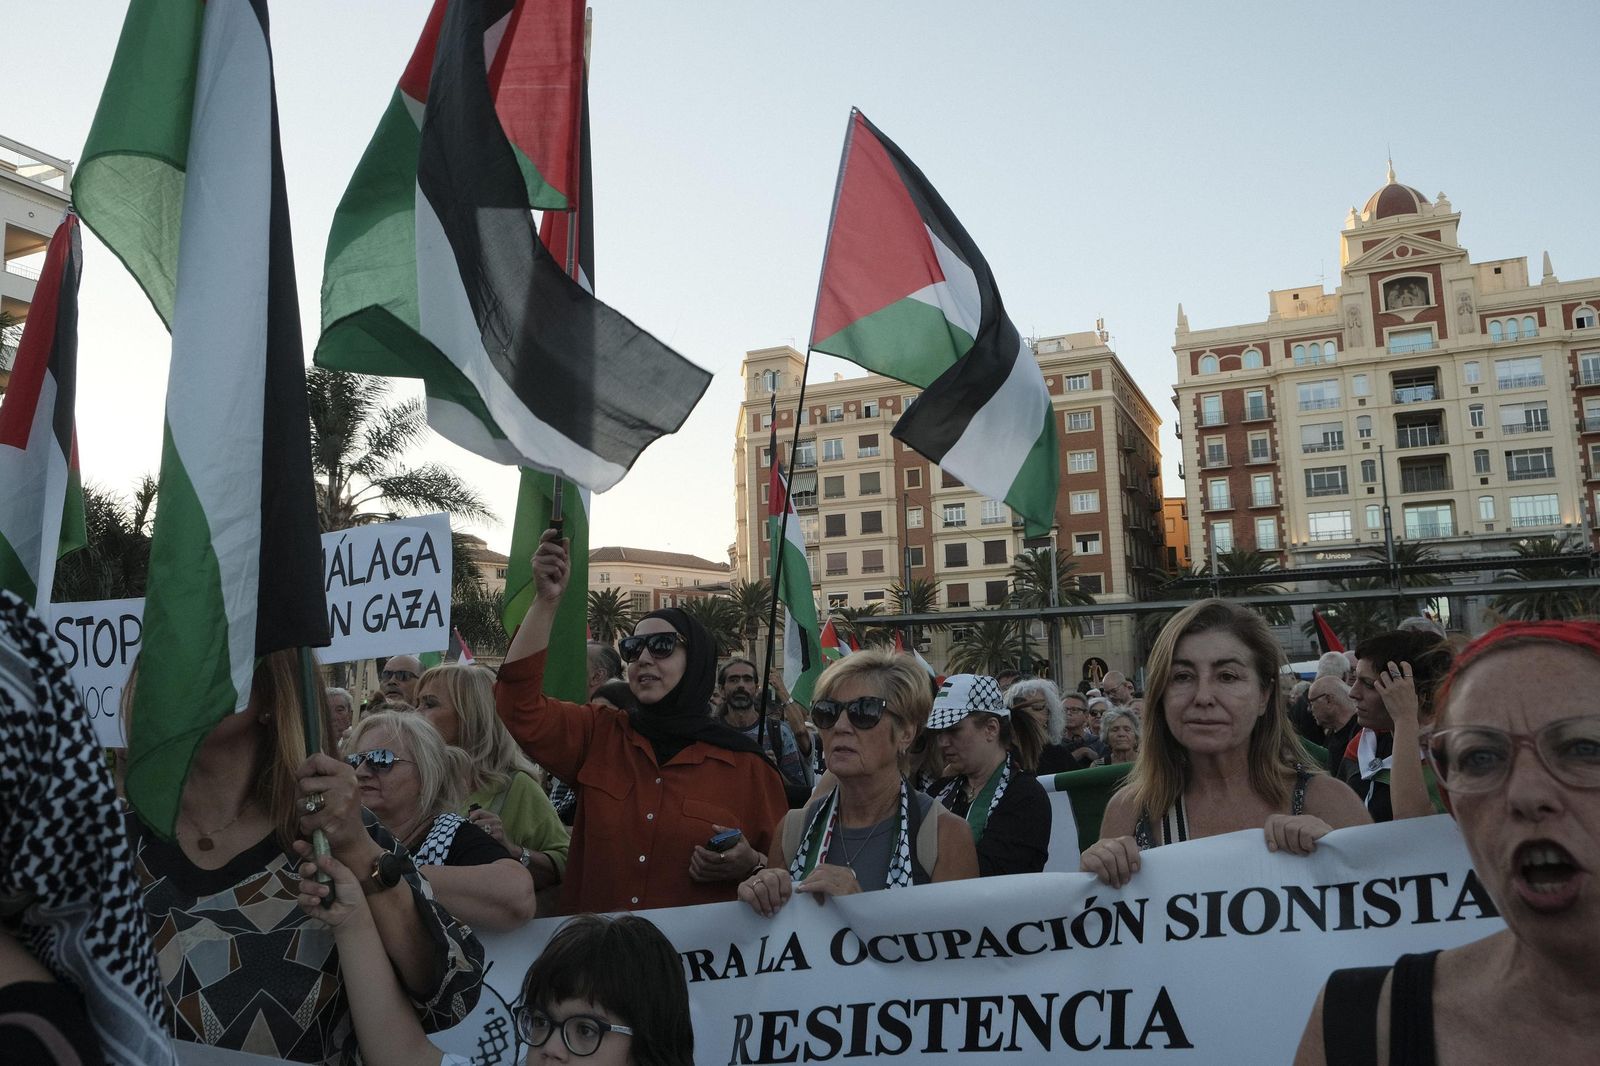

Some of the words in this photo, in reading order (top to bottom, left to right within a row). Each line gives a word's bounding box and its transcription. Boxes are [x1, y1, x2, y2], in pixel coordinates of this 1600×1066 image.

[55, 614, 143, 669] STOP
[330, 600, 352, 638] N
[362, 588, 445, 633] GAZA
[680, 942, 748, 983] RA
[754, 931, 812, 975] LA
[829, 896, 1150, 967] OCUPACIÓN
[1165, 868, 1501, 942] SIONISTA
[727, 985, 1194, 1066] RESISTENCIA
